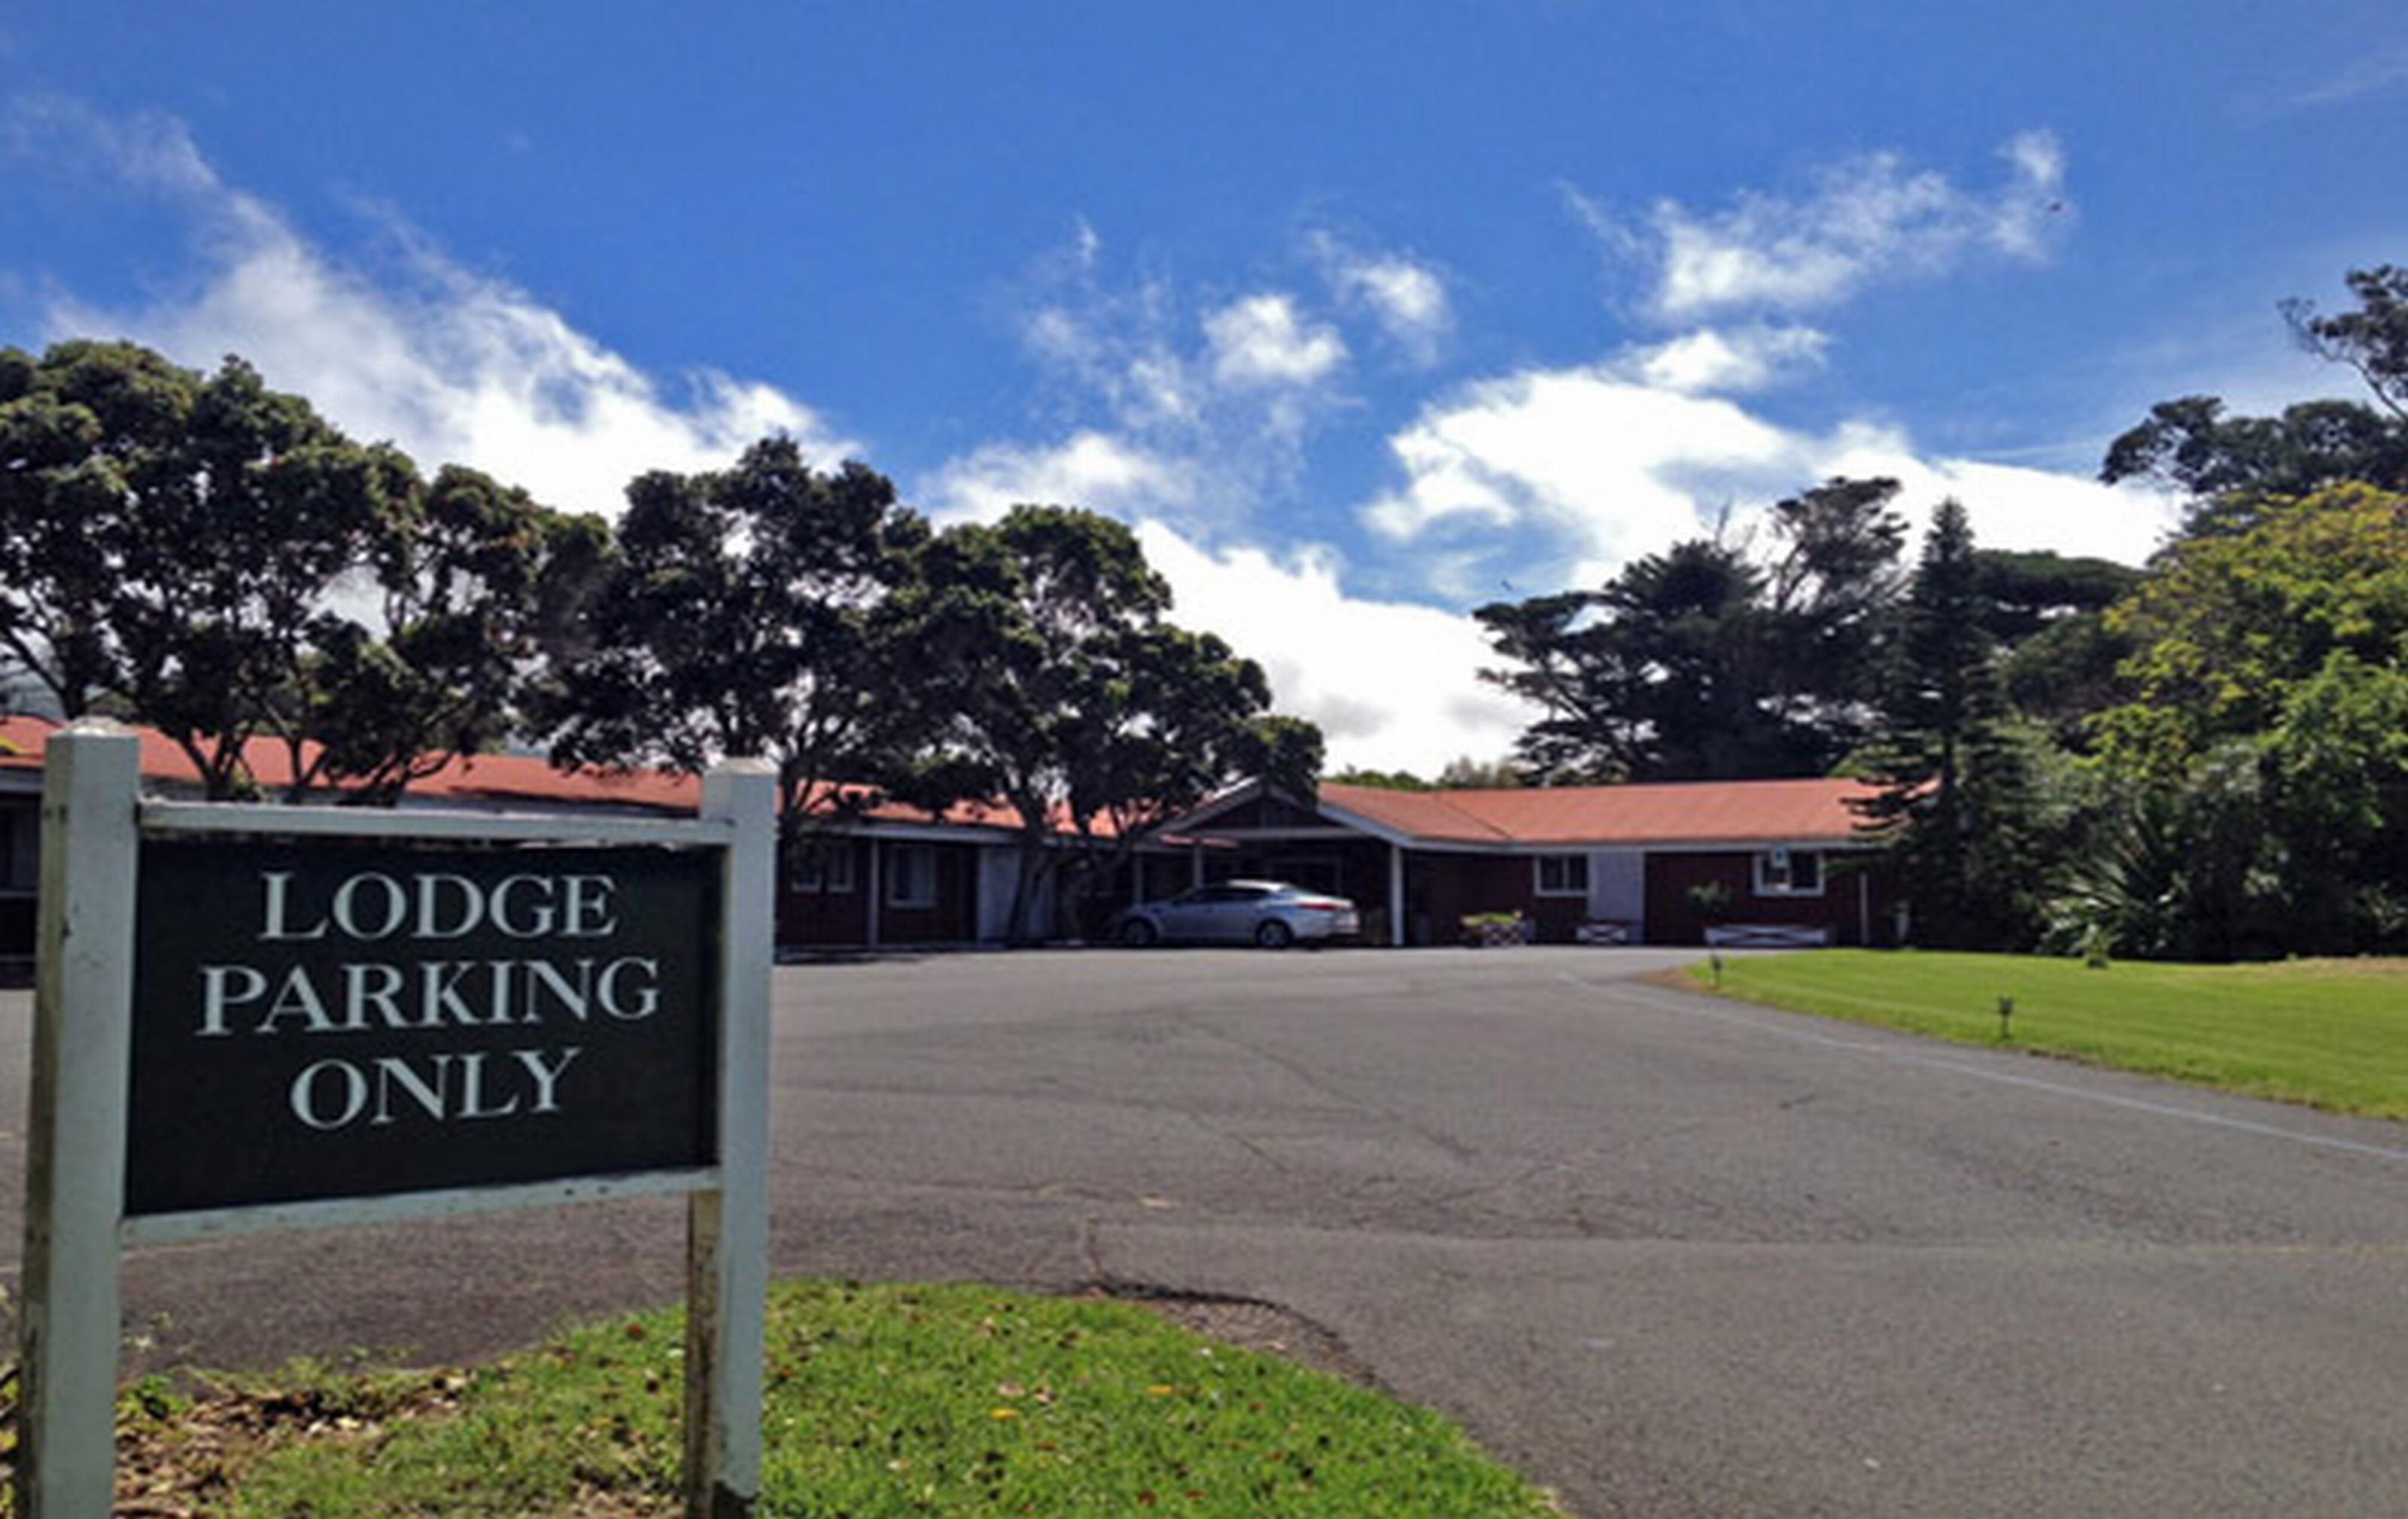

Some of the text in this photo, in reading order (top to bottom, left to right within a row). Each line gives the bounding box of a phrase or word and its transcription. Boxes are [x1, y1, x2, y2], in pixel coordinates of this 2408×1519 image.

[260, 872, 616, 939] LODGE
[197, 957, 660, 1037] PARKING
[290, 1049, 581, 1131] ONLY
